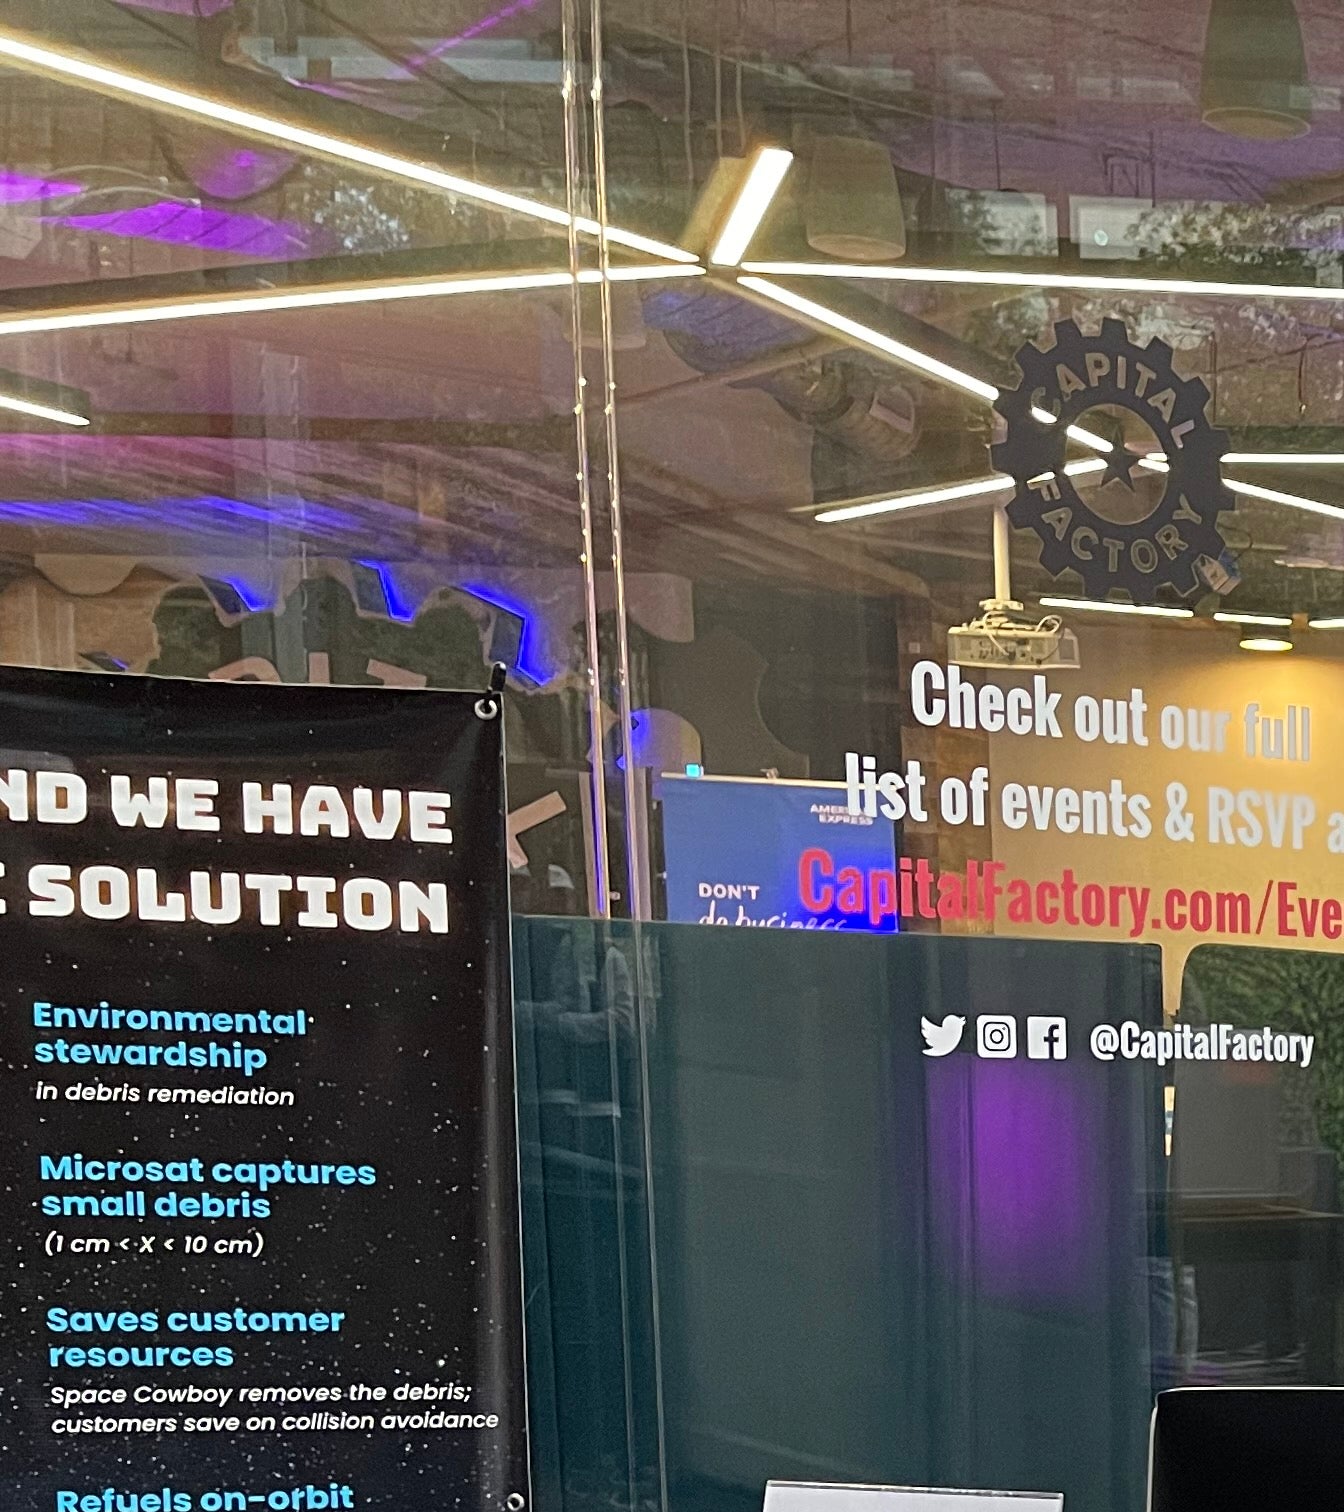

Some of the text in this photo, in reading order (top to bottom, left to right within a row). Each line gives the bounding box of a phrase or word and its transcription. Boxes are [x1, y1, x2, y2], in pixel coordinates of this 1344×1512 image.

[1031, 353, 1195, 449] CAPITAL
[1026, 471, 1202, 573] FACTORY
[910, 660, 1311, 762] Check out our full
[110, 775, 220, 831] WE
[242, 782, 453, 844] HAVE
[845, 752, 927, 823] list
[940, 767, 988, 827] of
[1001, 776, 1153, 839] events
[1164, 782, 1195, 842] &
[1208, 786, 1317, 850] RSVP
[28, 864, 449, 934] SOLUTION
[698, 882, 760, 899] DON'T
[33, 1002, 307, 1035] Environmental
[35, 1040, 267, 1076] stewardship
[1090, 1017, 1314, 1067] @CapitalFactory
[36, 1082, 295, 1106] in debris remediation
[40, 1154, 377, 1191] Microsat captures
[41, 1189, 271, 1219] small debris
[44, 1231, 64, 1256] (1
[70, 1237, 110, 1254] cm
[139, 1236, 154, 1254] X
[184, 1236, 208, 1254] 10
[213, 1232, 265, 1257] cm)
[46, 1306, 346, 1332] Saves customer
[49, 1345, 234, 1368] resources
[50, 1382, 472, 1407] Space Cowboy removes the debris;
[51, 1411, 499, 1433] customers save on collision avoidance
[200, 1483, 354, 1512] on-orbit
